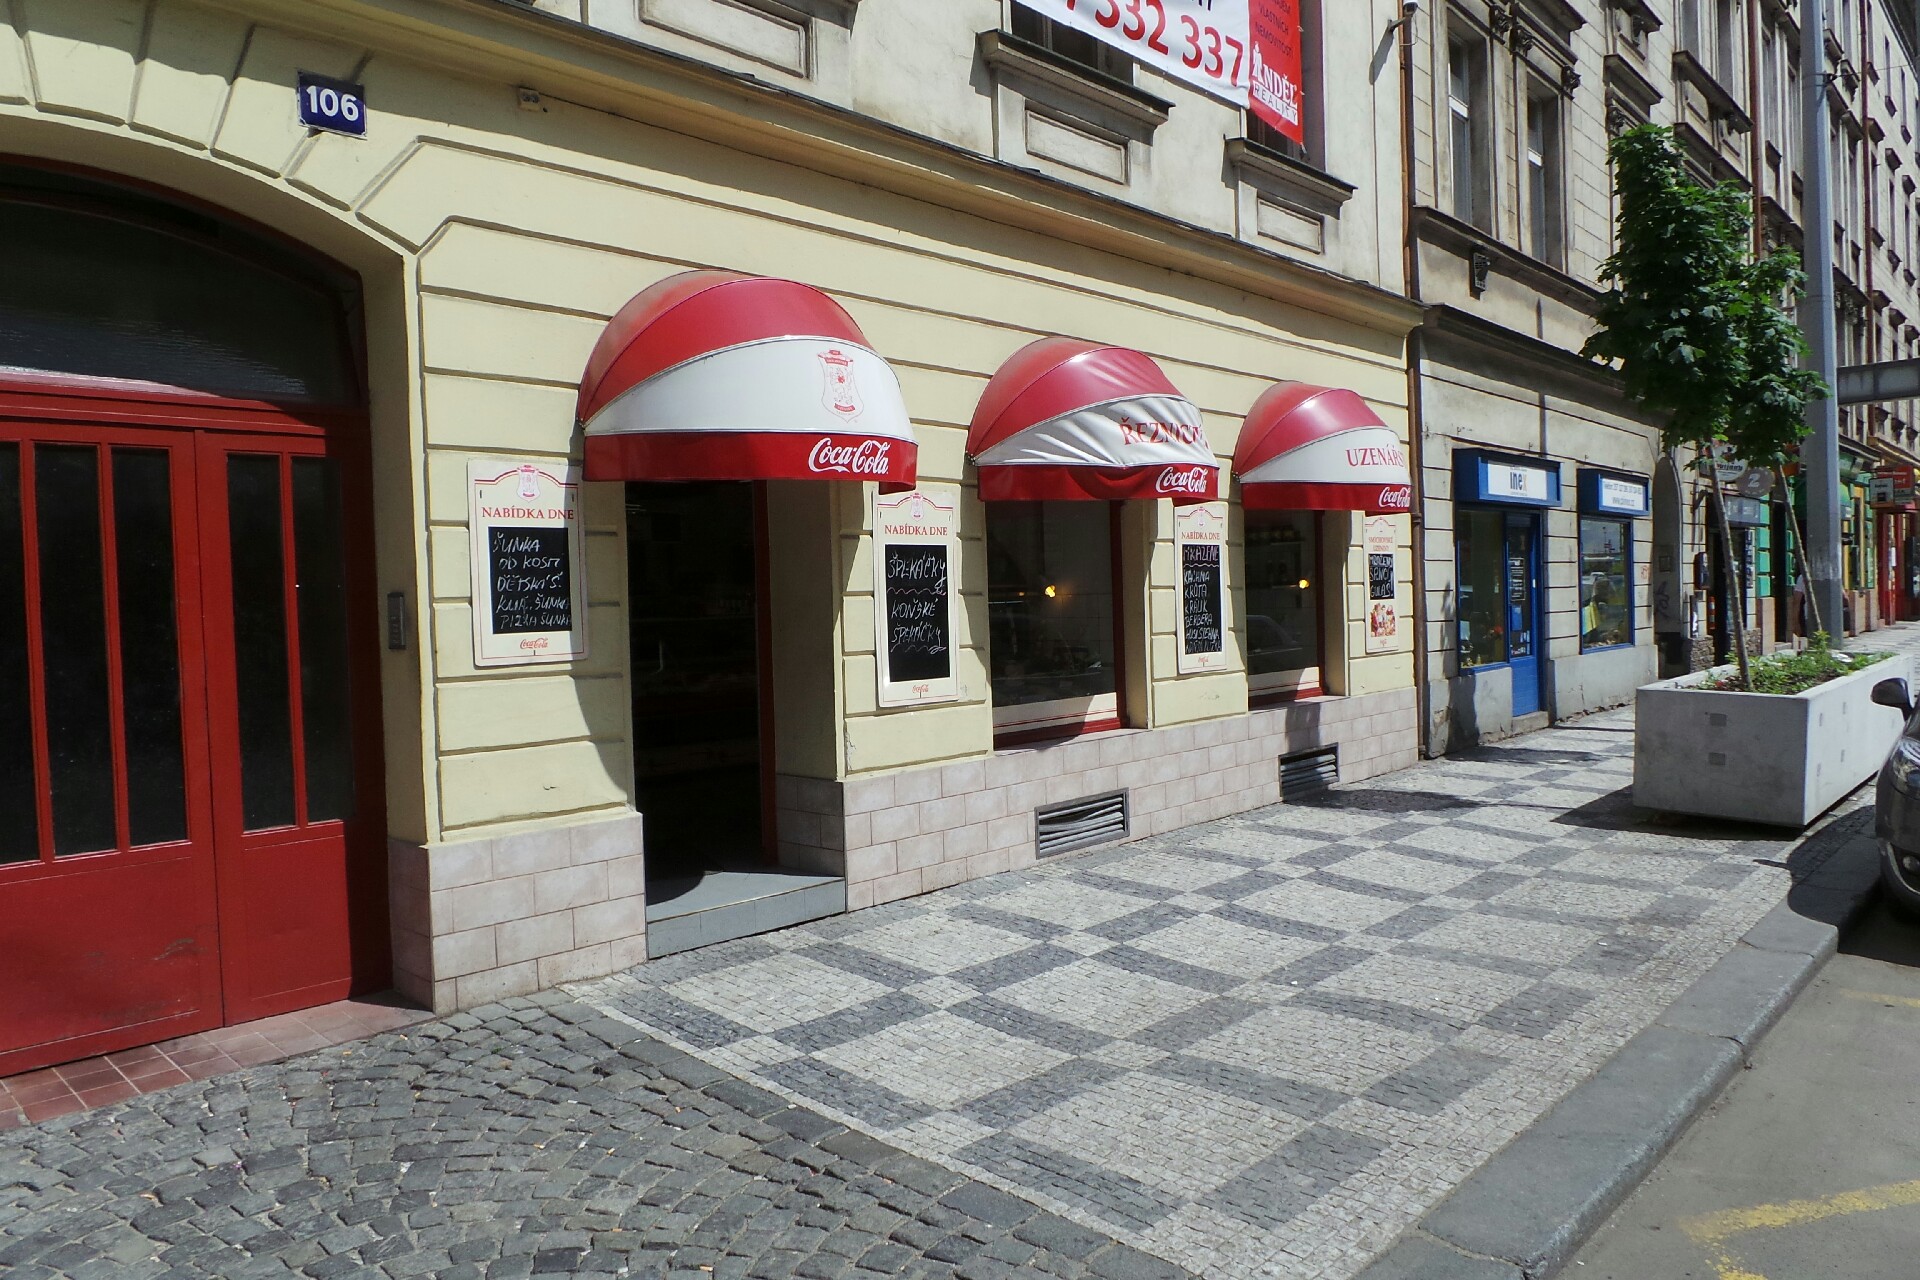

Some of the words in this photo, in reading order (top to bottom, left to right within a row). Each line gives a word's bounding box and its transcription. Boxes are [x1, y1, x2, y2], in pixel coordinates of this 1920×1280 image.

[1180, 15, 1244, 87] 337
[306, 85, 359, 122] 106
[482, 505, 545, 519] NABÍDKA
[548, 509, 574, 520] DNE
[884, 523, 928, 536] NABÍDKA
[929, 526, 948, 536] DNE
